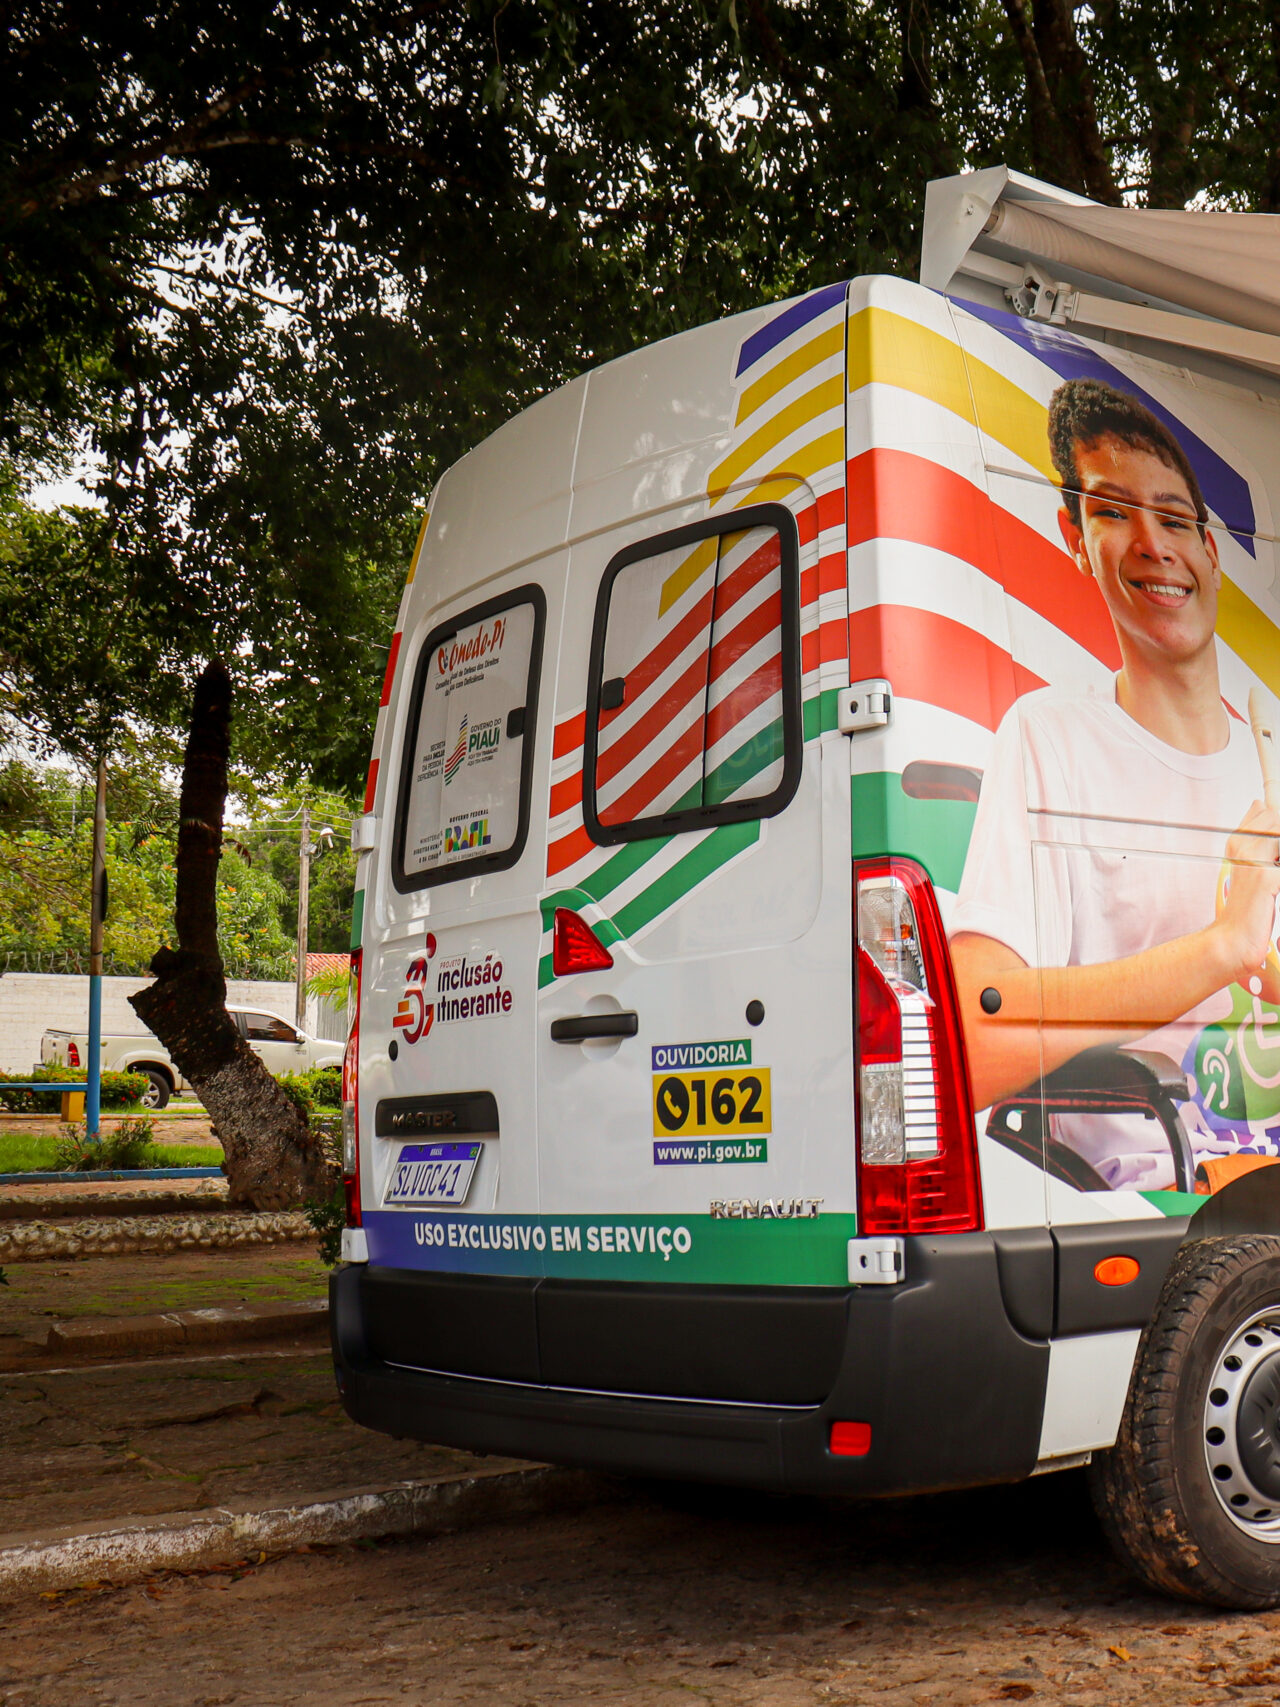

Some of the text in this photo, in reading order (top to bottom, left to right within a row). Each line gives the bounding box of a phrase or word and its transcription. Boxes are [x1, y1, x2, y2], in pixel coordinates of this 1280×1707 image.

[471, 720, 493, 733] GOVERNO
[444, 818, 492, 853] BRASIL
[437, 955, 503, 993] inclusão
[440, 958, 462, 969] PROJETO
[437, 986, 512, 1022] itinerante
[655, 1043, 748, 1067] OUVIDORIA
[691, 1076, 763, 1125] 162
[392, 1110, 457, 1129] MASTER
[657, 1141, 762, 1163] www.pi.gov.br
[710, 1198, 824, 1220] RENAULT
[414, 1222, 692, 1261] USO EXCLUSIVO EM SERVIÇO
